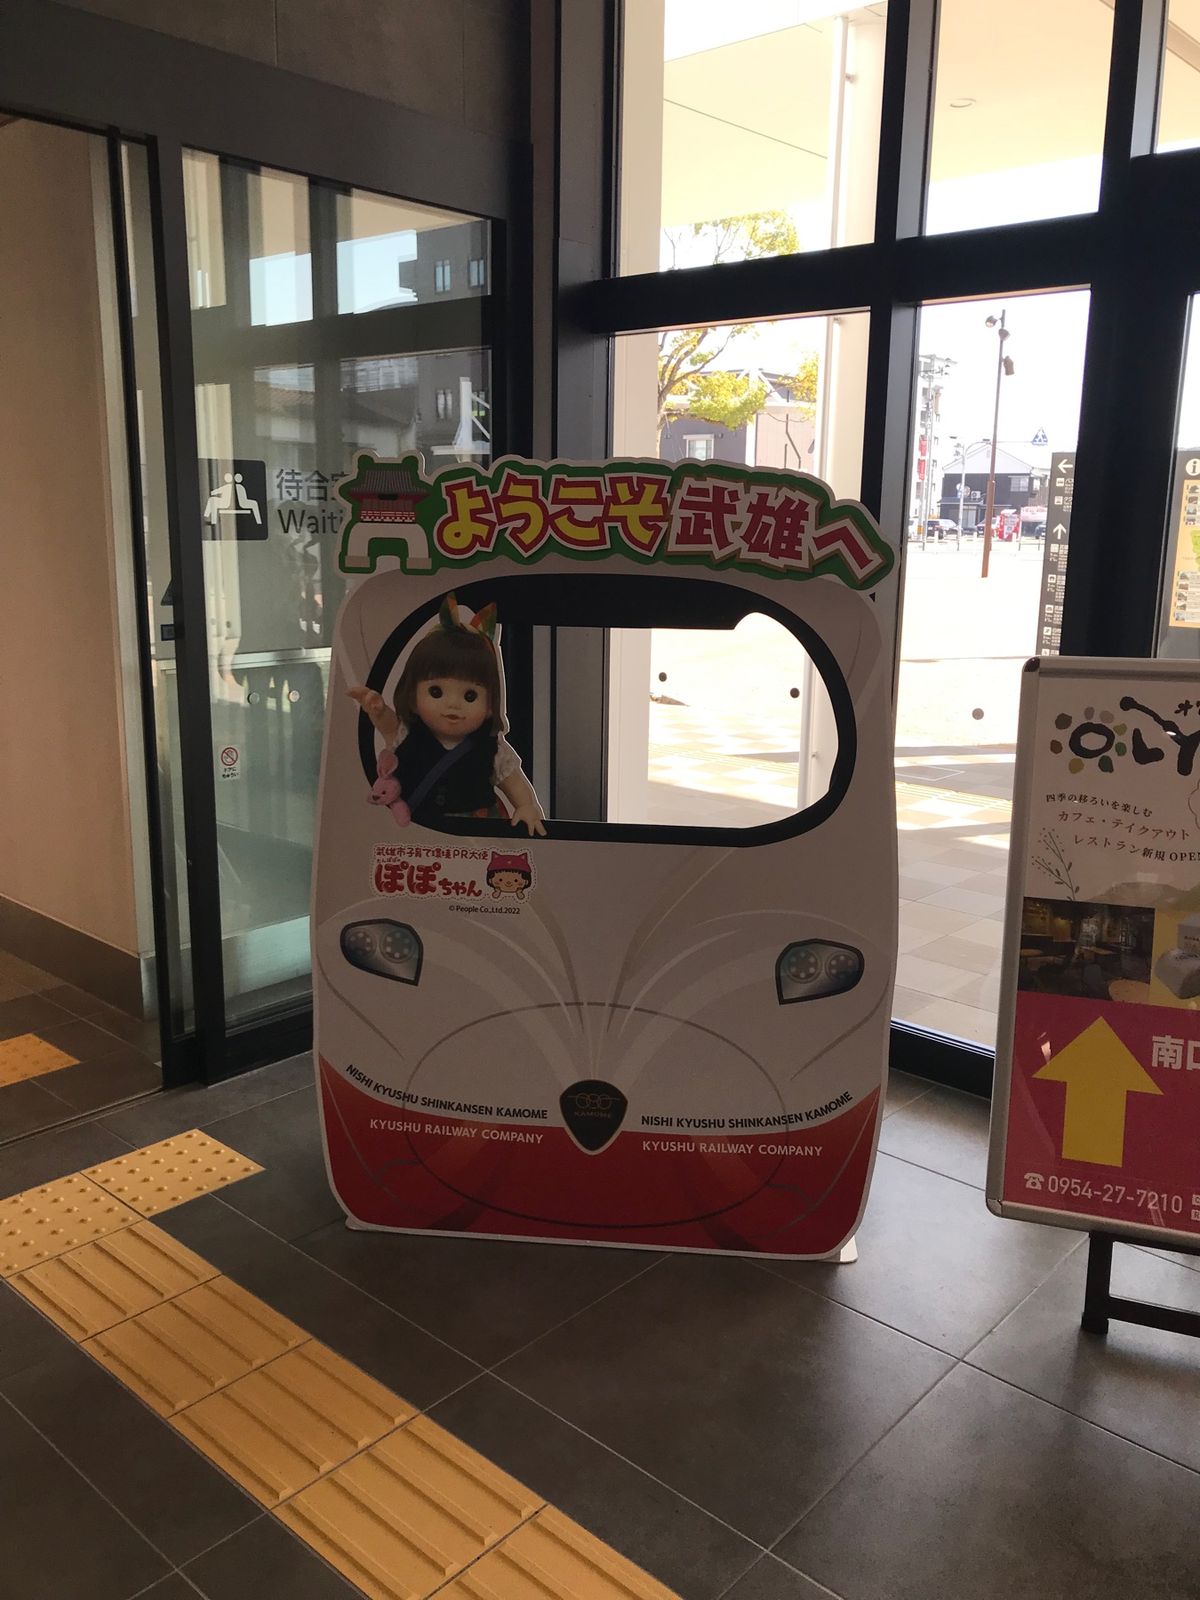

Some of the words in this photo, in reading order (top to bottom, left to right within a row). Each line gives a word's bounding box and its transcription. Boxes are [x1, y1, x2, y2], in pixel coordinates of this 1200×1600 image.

[434, 470, 884, 582] ようこそ武雄へ
[1045, 793, 1153, 818] 四季の移ろいを楽しむ
[374, 861, 482, 898] ぽぽちゃん
[456, 905, 479, 914] People
[345, 1063, 374, 1088] NISHI
[373, 1082, 419, 1105] KYUSHU
[420, 1096, 493, 1116] SHINKANSEN
[496, 1106, 548, 1119] KAMOME
[641, 1115, 673, 1128] NISHI
[676, 1117, 725, 1129] KYUSHU
[728, 1112, 803, 1129] SHINKANSEN
[805, 1091, 853, 1121] KAMOME
[370, 1118, 421, 1133] KYUSHU
[424, 1123, 478, 1138] RAILWAY
[481, 1128, 544, 1144] COMPANY
[642, 1140, 696, 1152] KYUSHU
[699, 1142, 754, 1155] RAILWAY
[758, 1144, 823, 1157] COMPANY
[1048, 1175, 1183, 1214] 0954-27-7210
